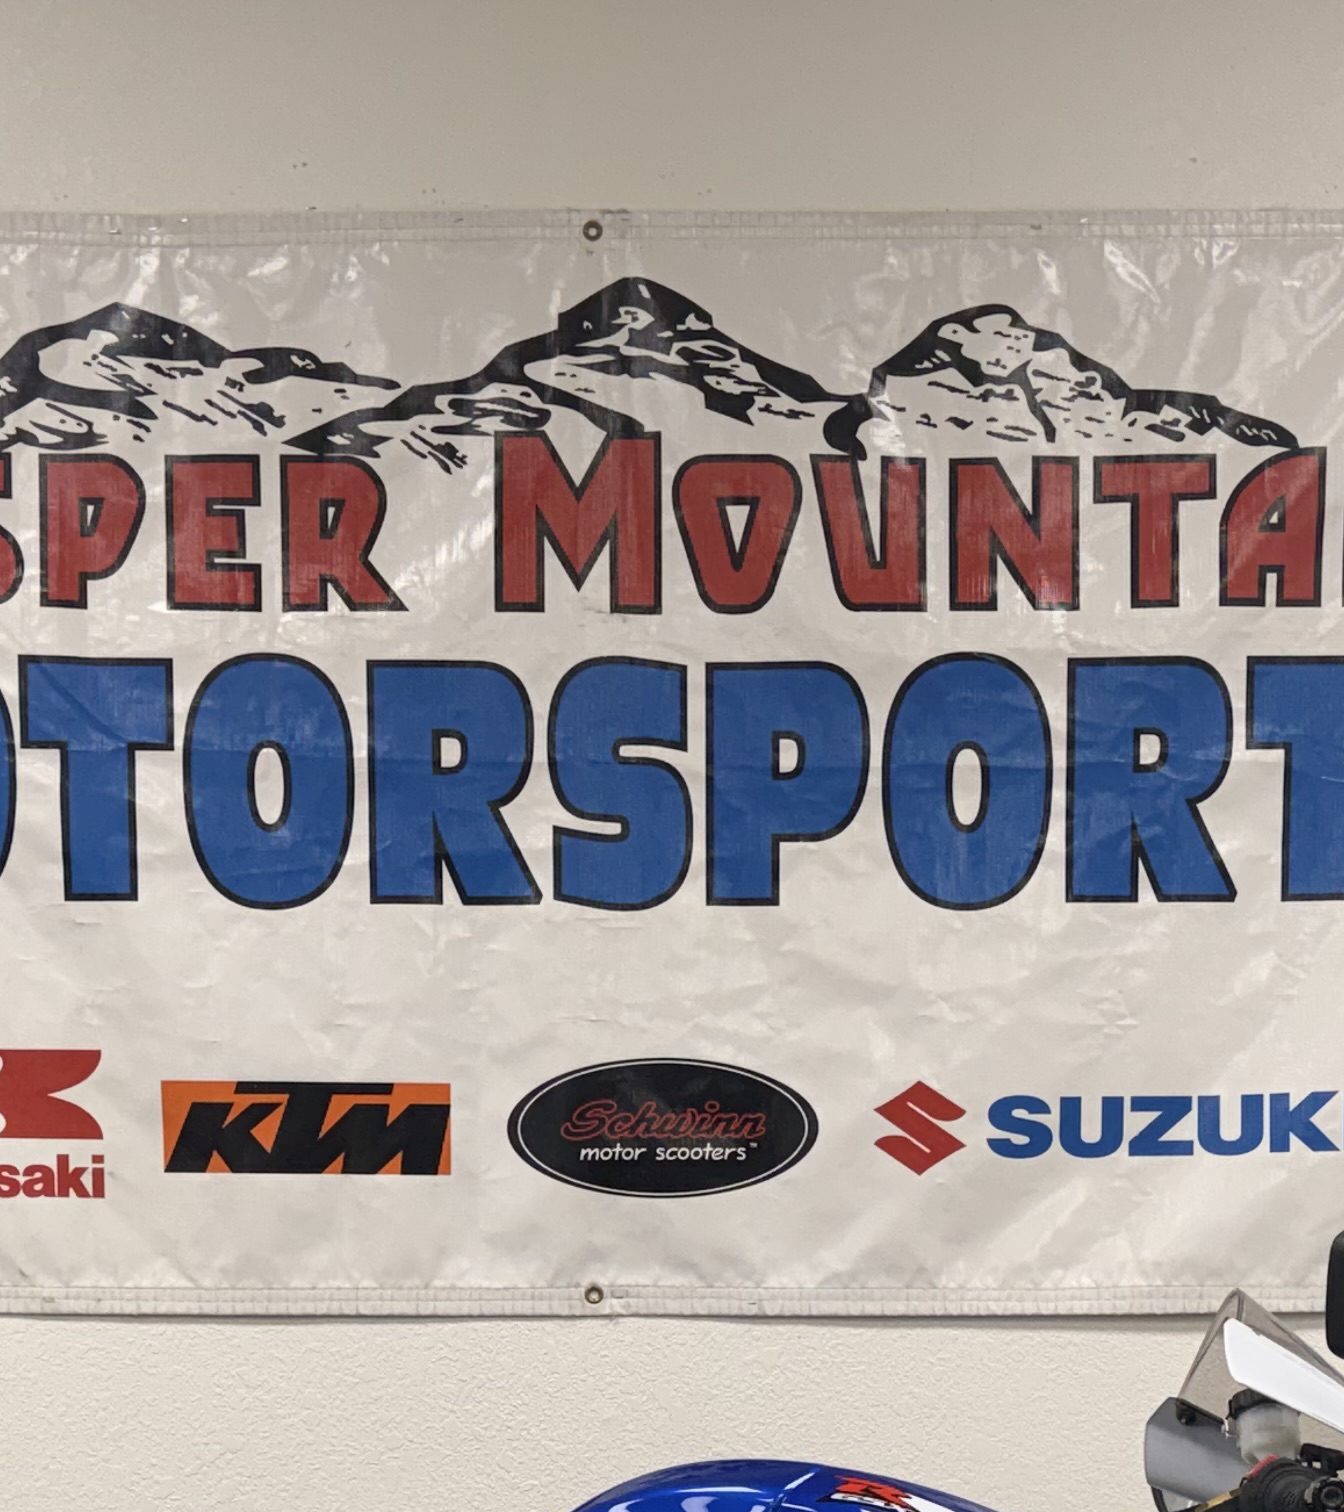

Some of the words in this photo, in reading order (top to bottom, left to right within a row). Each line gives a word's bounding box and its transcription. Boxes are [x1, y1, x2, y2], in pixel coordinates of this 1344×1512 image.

[164, 1081, 452, 1176] KTM
[560, 1099, 767, 1141] Schwinn
[579, 1142, 647, 1161] motor
[655, 1142, 747, 1161] scooters
